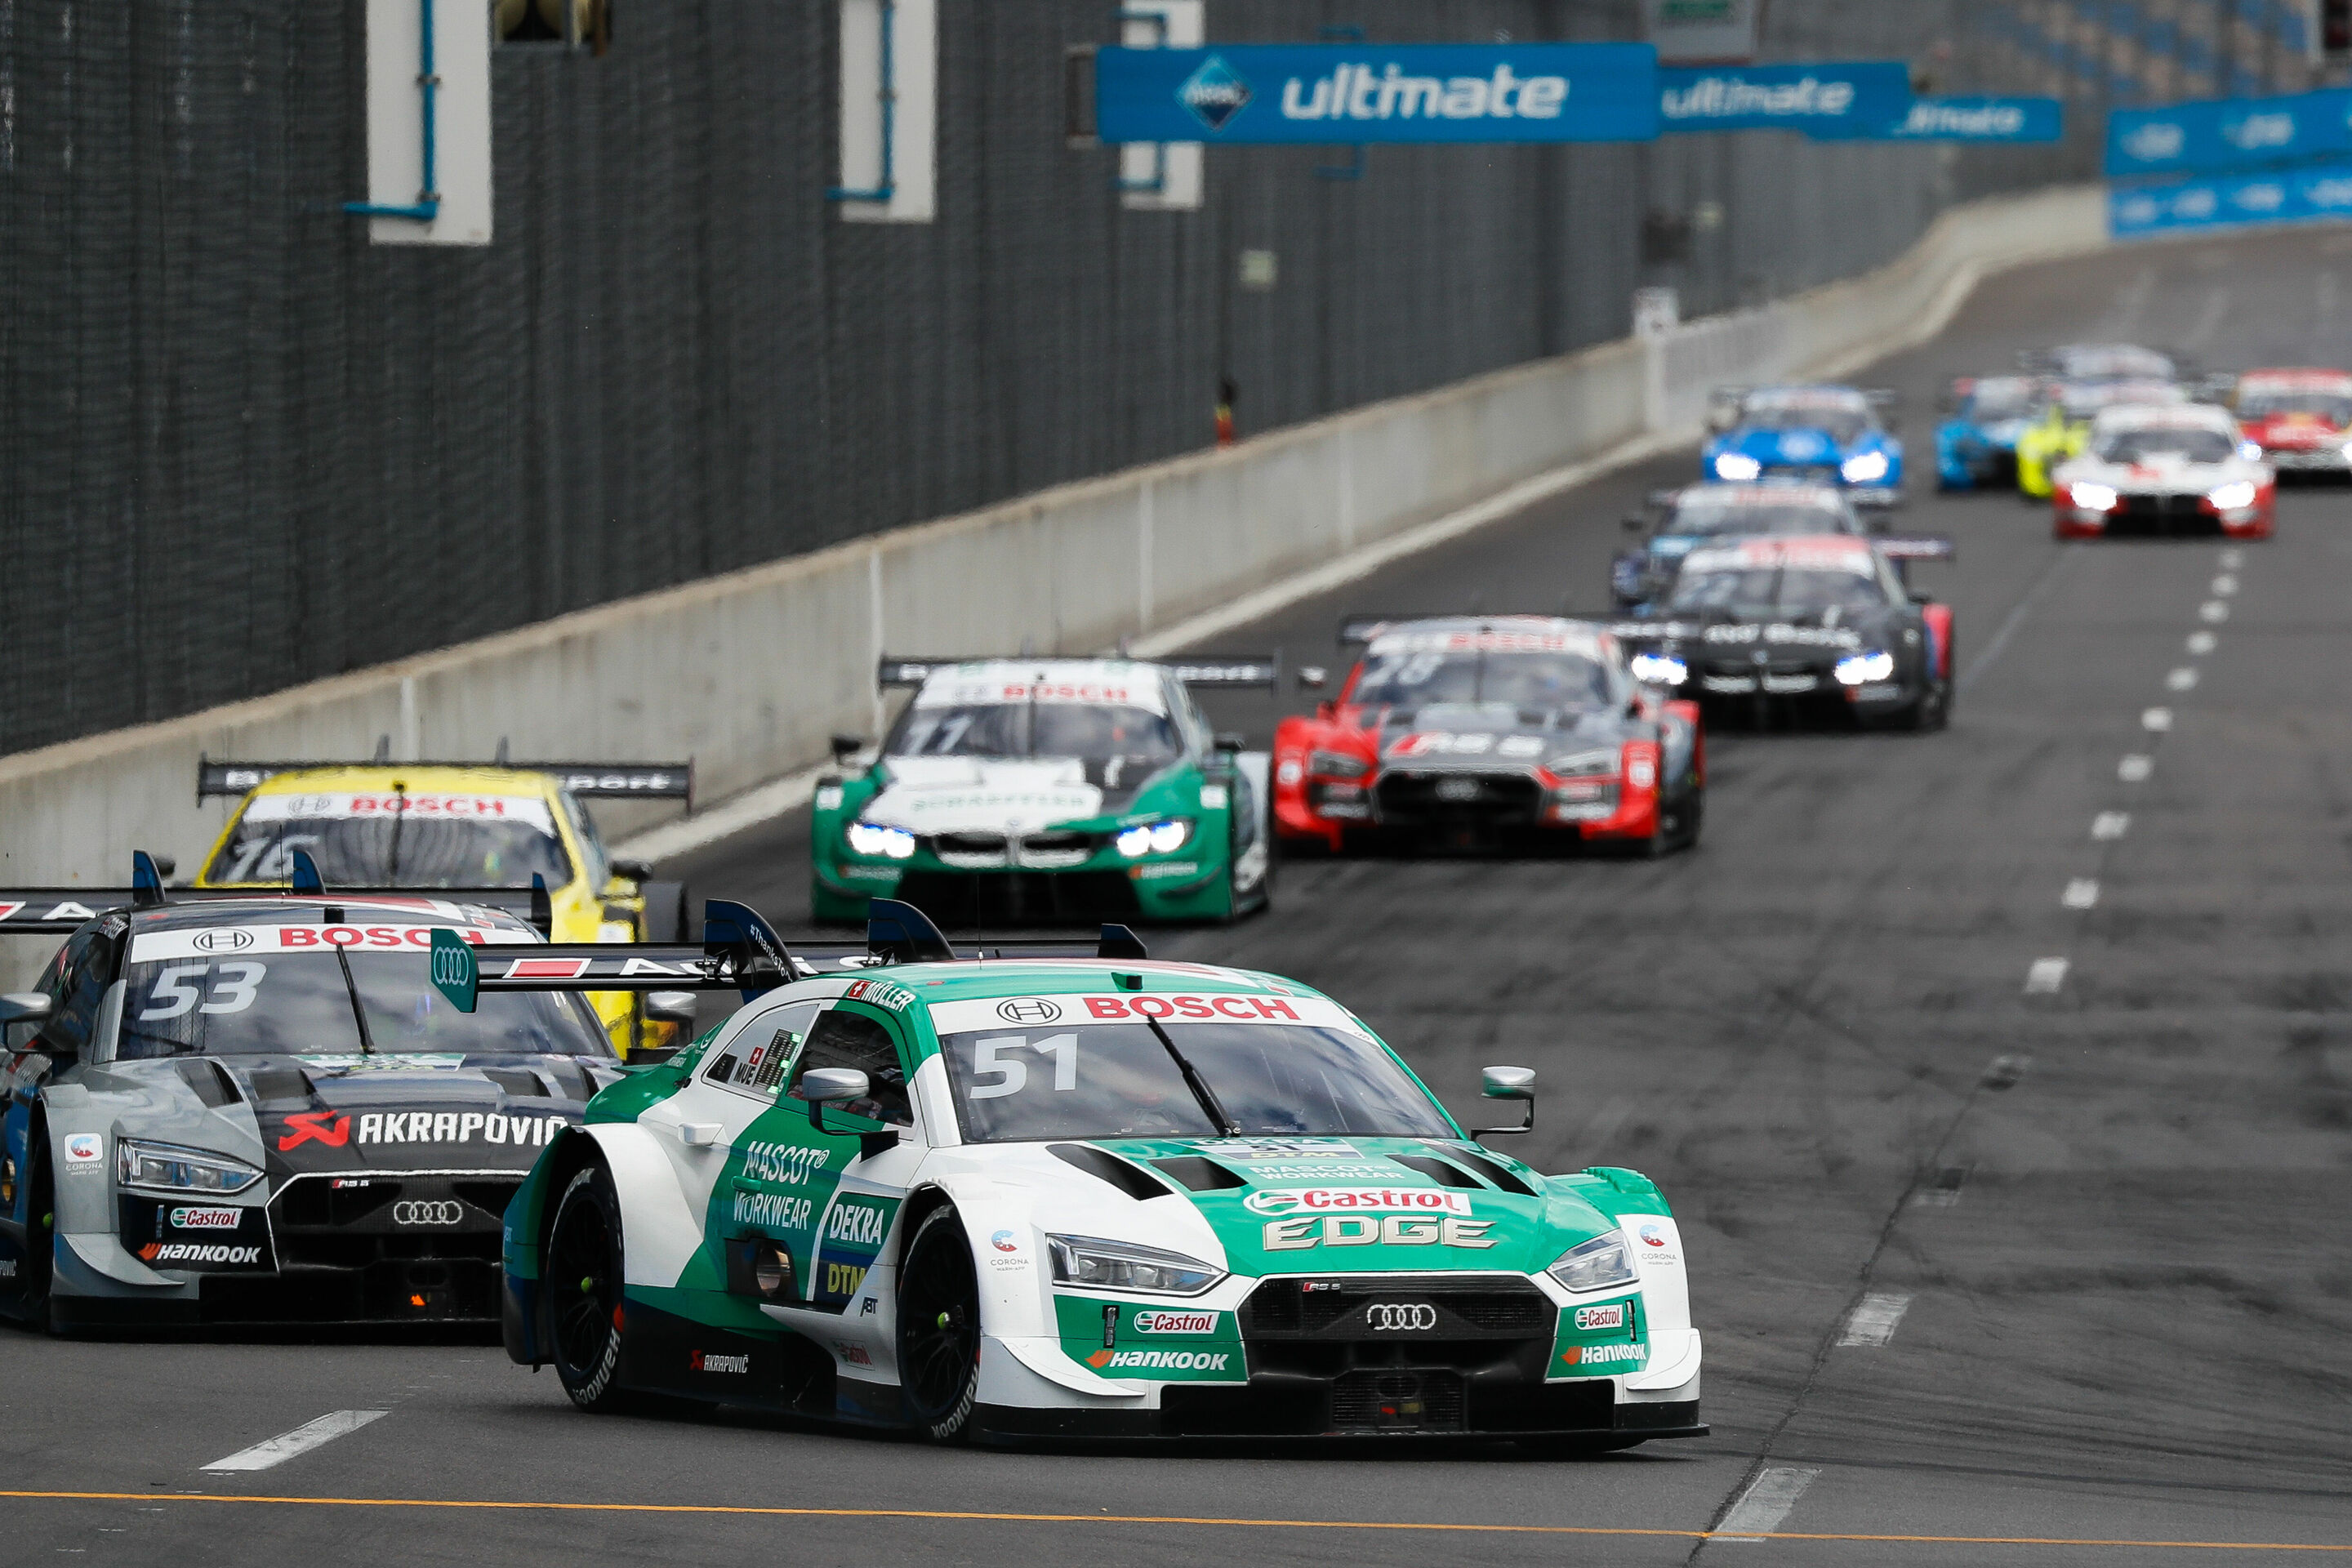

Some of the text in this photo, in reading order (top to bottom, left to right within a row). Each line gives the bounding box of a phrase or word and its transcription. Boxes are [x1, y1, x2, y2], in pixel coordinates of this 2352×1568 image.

[1281, 63, 1570, 120] ultimate
[1661, 77, 1854, 118] ultimate
[1003, 684, 1129, 703] BOSCH
[349, 797, 506, 817] BOSCH
[139, 961, 268, 1022] 53
[862, 980, 916, 1013] MÜLLER
[1083, 996, 1302, 1021] BOSCH
[969, 1033, 1078, 1099] 51
[1259, 1171, 1405, 1180] WORKWEAR
[734, 1191, 813, 1230] WORKWEAR
[1303, 1190, 1461, 1211] Castrol
[186, 1209, 237, 1226] Castrol
[830, 1204, 884, 1245] DEKRA
[1263, 1215, 1499, 1251] EDGE
[991, 1258, 1030, 1266] CORONA
[1154, 1313, 1214, 1331] Castrol
[1588, 1307, 1620, 1326] Castrol
